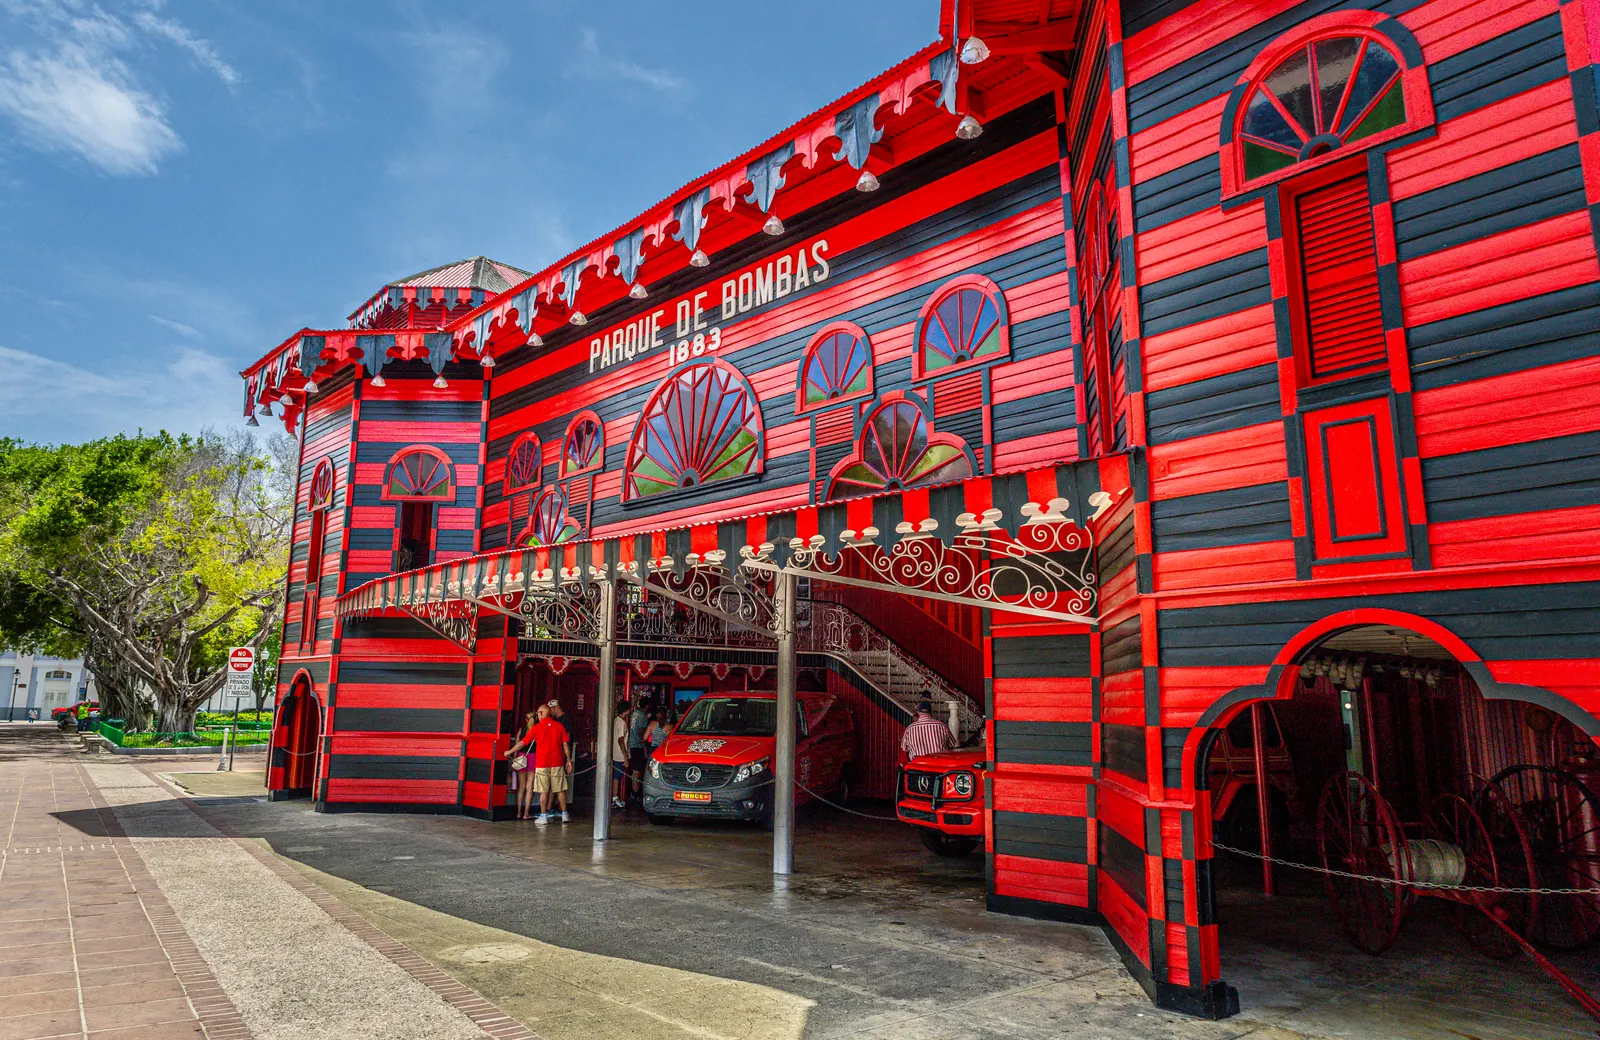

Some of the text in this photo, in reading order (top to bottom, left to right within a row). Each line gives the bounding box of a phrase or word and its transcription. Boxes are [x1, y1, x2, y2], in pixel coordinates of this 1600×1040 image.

[589, 239, 830, 373] PARQUE DE BOMBAS
[669, 327, 722, 366] 1883
